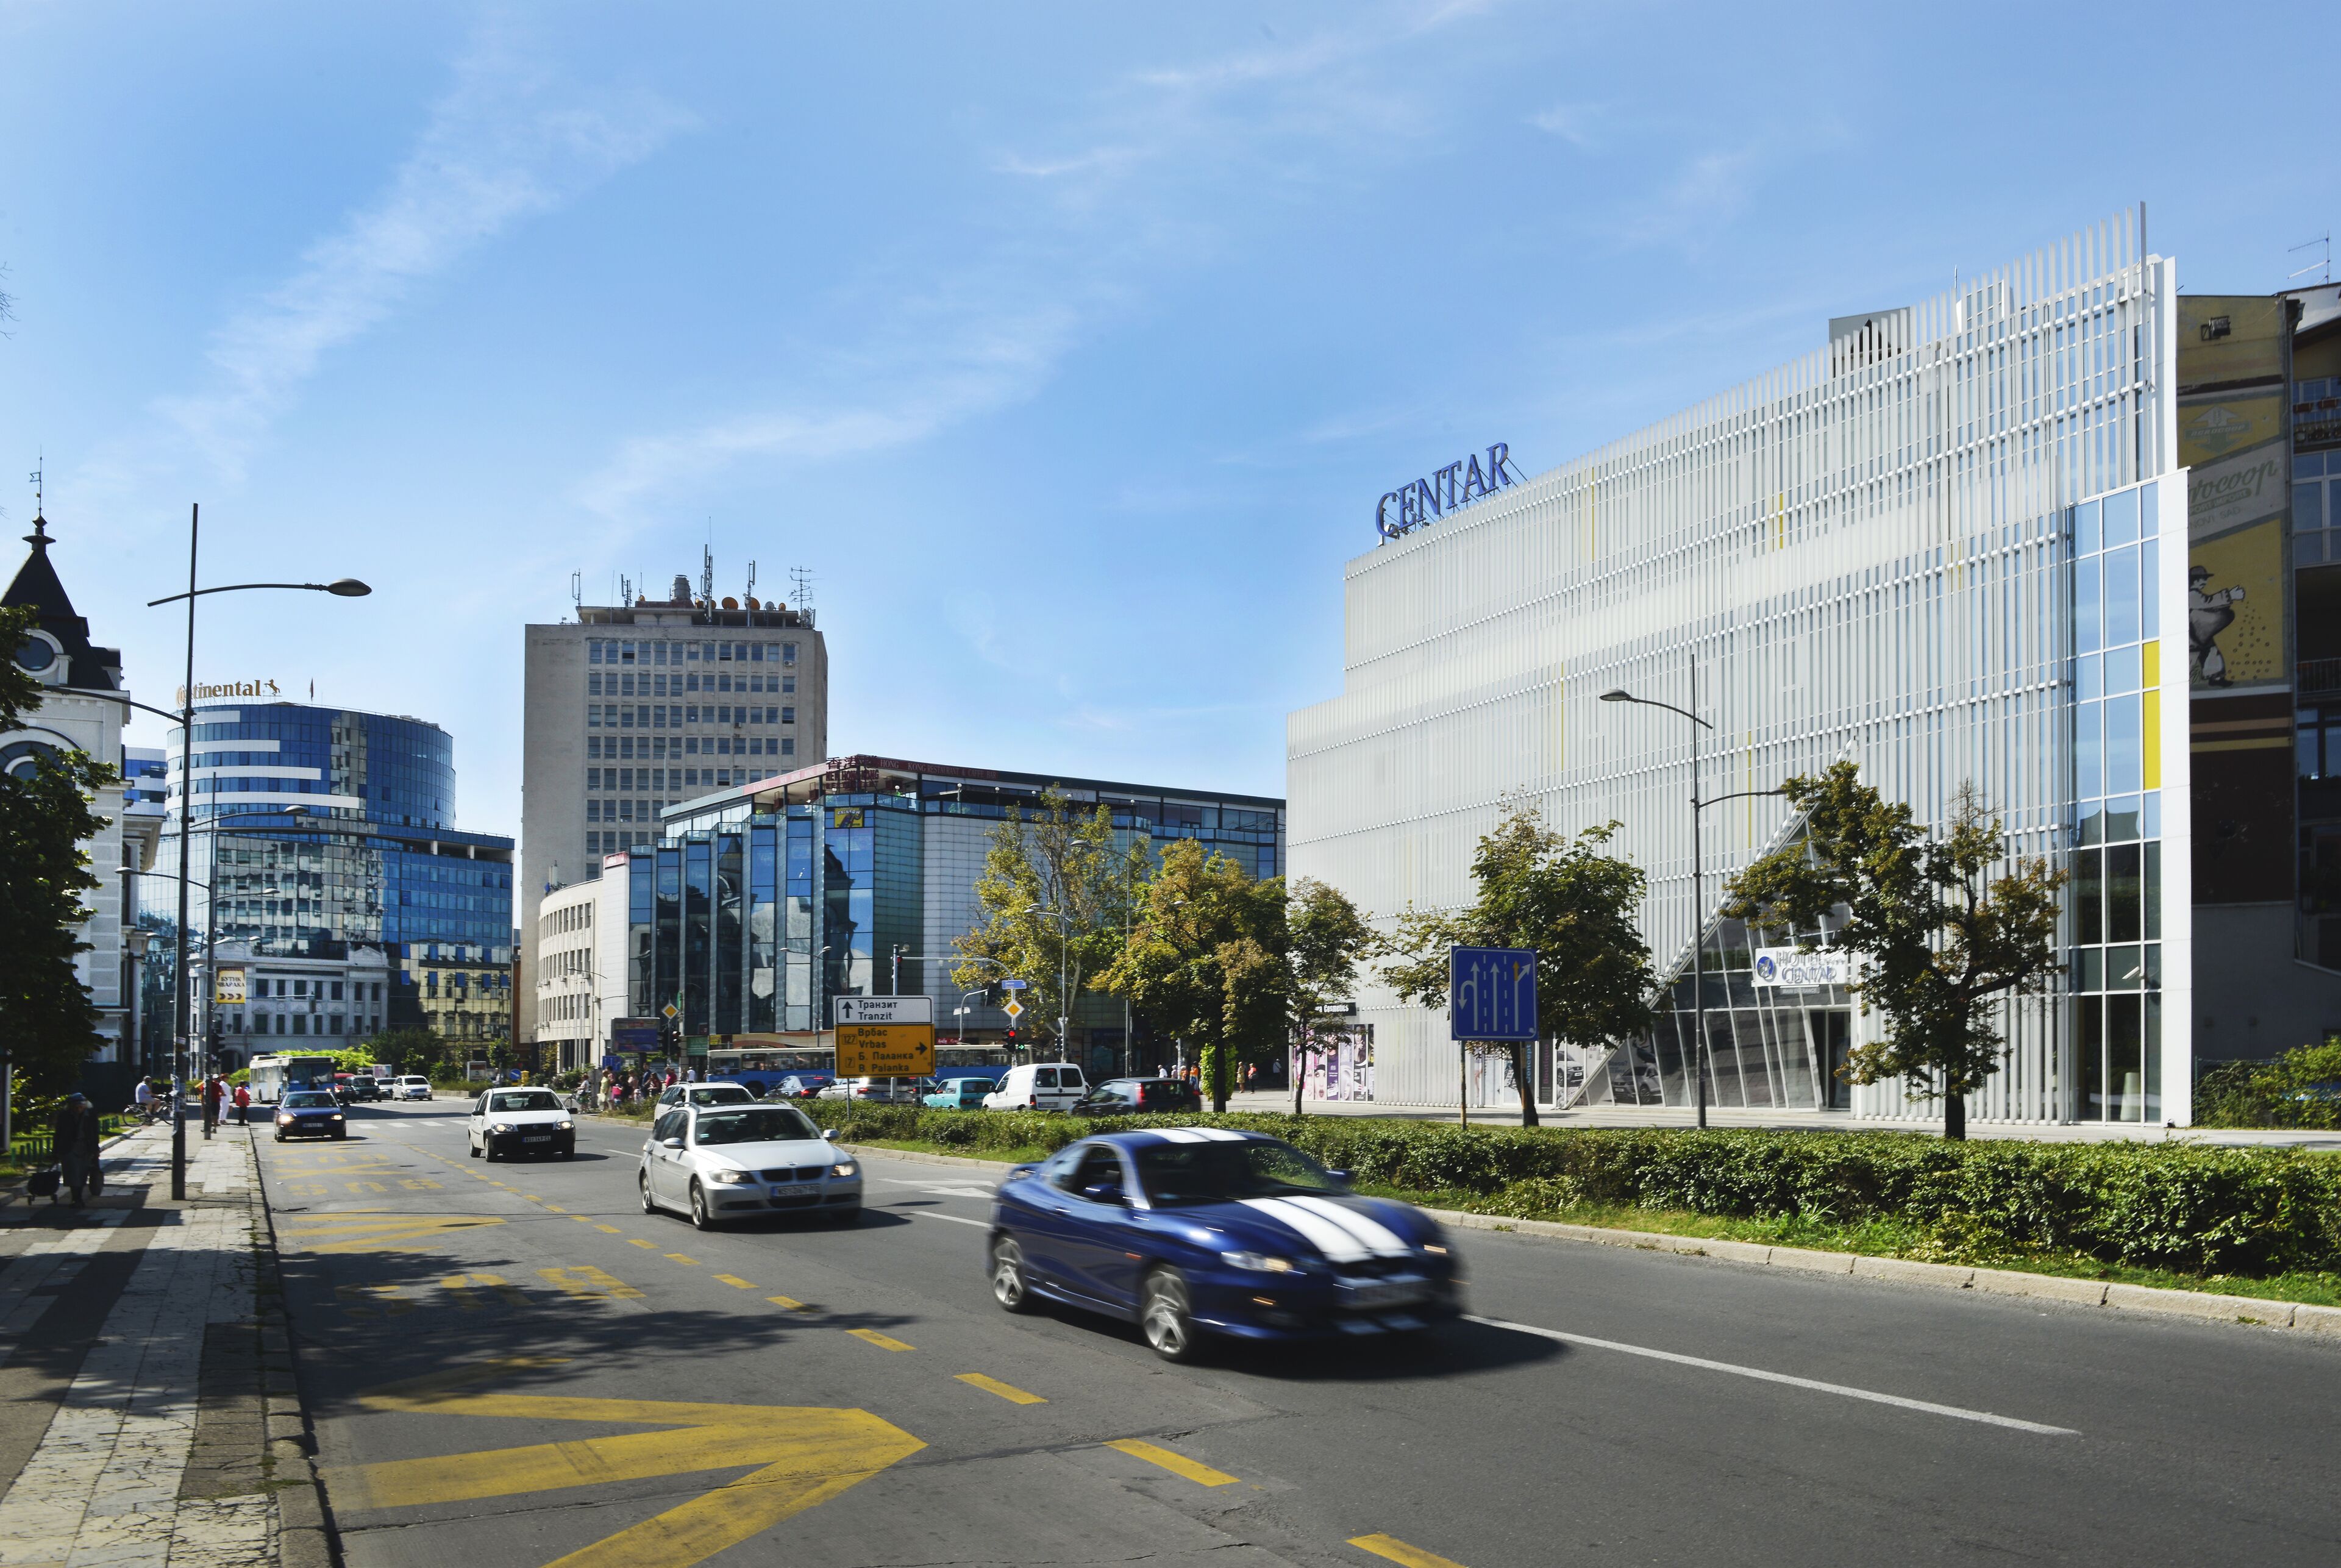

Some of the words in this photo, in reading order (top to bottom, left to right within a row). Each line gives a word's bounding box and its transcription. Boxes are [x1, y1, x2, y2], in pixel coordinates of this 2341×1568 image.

[2189, 460, 2278, 505] rocoop
[1376, 442, 1511, 536] CENTAR
[2220, 507, 2241, 519] SAD
[880, 759, 899, 769] HONG
[907, 762, 925, 772] KONG
[1776, 950, 1825, 967] HOTEL
[1781, 965, 1837, 984] CENTAR
[858, 1000, 898, 1010] Транзит
[1324, 1004, 1349, 1013] Cosmetics
[858, 1012, 893, 1021] Tranzit
[858, 1028, 888, 1038] Врбас
[843, 1035, 856, 1044] 127
[859, 1040, 887, 1049] Vrbas
[858, 1052, 869, 1061] Б.
[872, 1052, 914, 1060] Паланка
[872, 1063, 910, 1072] Palanka
